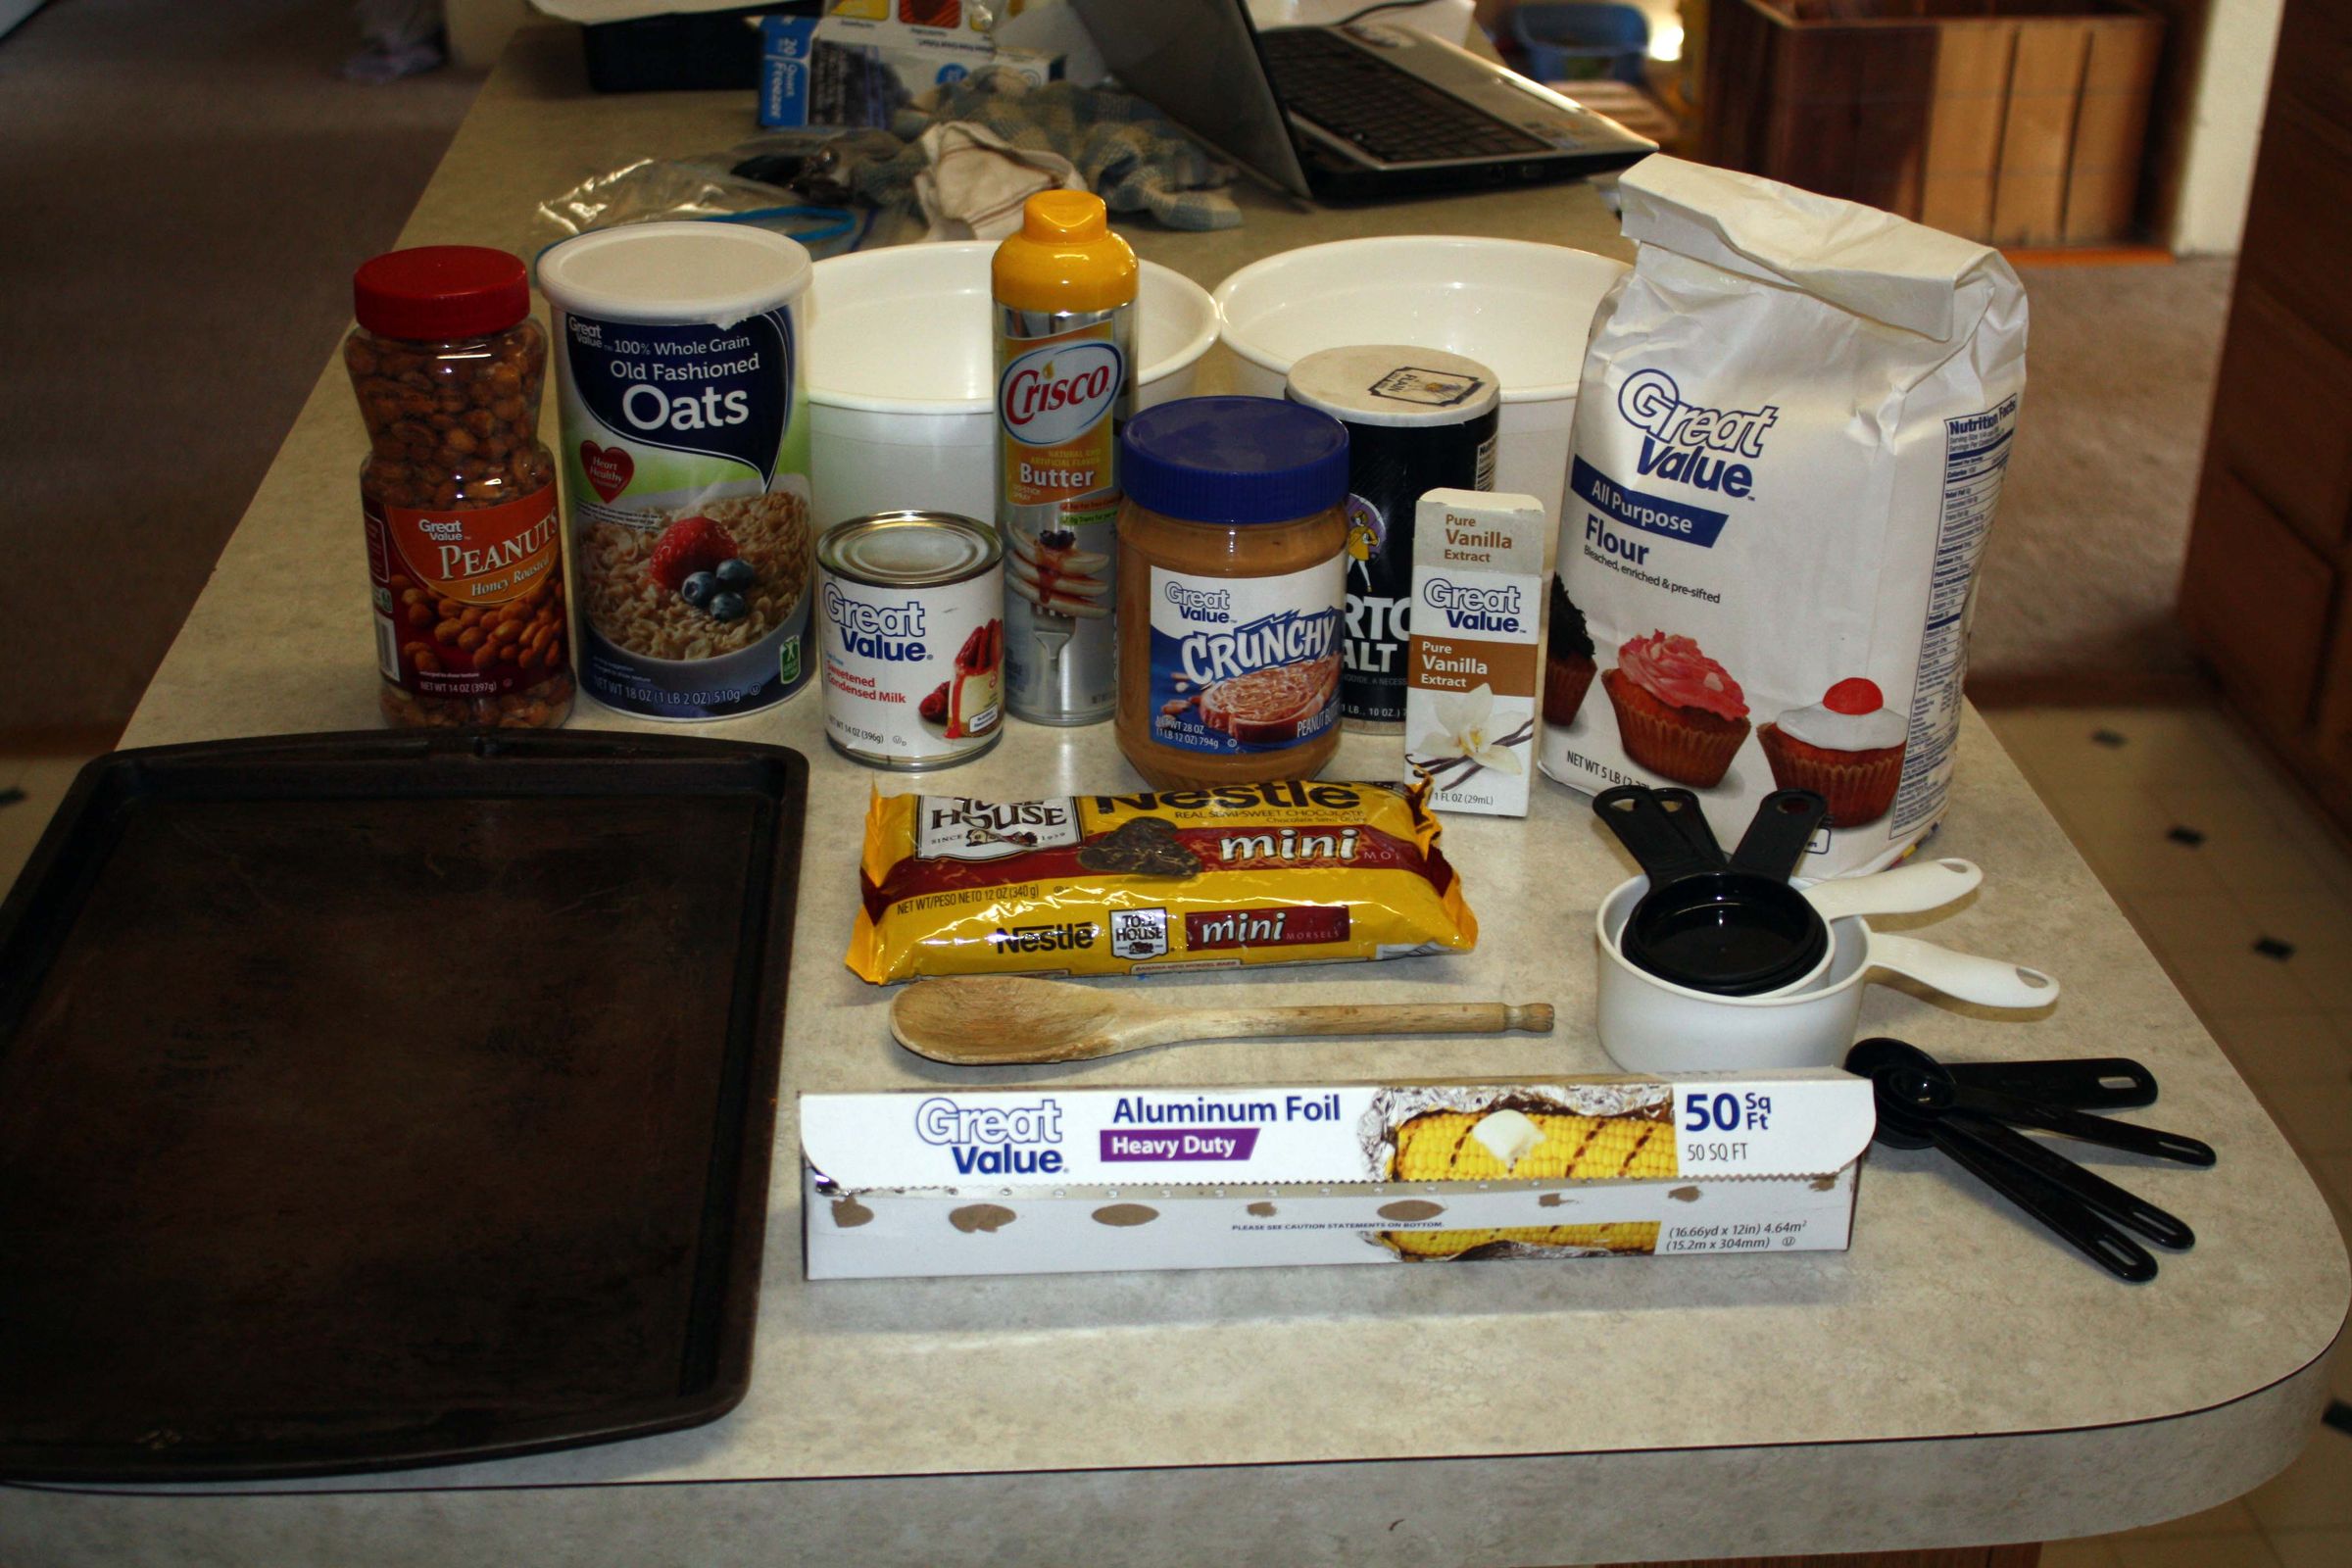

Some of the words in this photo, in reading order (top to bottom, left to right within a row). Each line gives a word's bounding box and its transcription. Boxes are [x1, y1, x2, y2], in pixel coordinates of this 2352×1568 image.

[568, 317, 602, 338] Great
[614, 340, 651, 355] 100%
[654, 339, 708, 356] Whole
[710, 335, 751, 353] Grain
[611, 360, 647, 379] Old
[654, 353, 760, 381] Fashioned
[1005, 365, 1109, 425] Crisco
[622, 384, 750, 431] Oats
[1618, 368, 1780, 459] Great
[1948, 414, 1998, 435] Nutrition
[593, 456, 618, 470] Heart
[1637, 434, 1753, 498] Value
[1020, 463, 1095, 487] Butter
[1592, 479, 1610, 505] All
[1611, 492, 1692, 534] Purpose
[418, 518, 462, 533] Great
[1446, 514, 1476, 527] Pure
[430, 532, 463, 541] Value
[438, 507, 558, 580] PEANUTS
[1446, 528, 1513, 549] Vanilla
[1586, 513, 1649, 565] Flour
[1444, 549, 1491, 563] Extract
[471, 578, 510, 597] Honey
[514, 555, 550, 584] Roasted
[1584, 544, 1620, 572] Bleached,
[1621, 565, 1660, 587] enriched
[1661, 578, 1671, 589] &
[1671, 583, 1721, 604] pre-sifted
[1164, 581, 1230, 611] Great
[1424, 577, 1521, 614] Great
[823, 582, 925, 638] Great
[1180, 605, 1230, 624] Value
[1446, 609, 1519, 632] Value
[841, 627, 926, 662] Value
[1182, 613, 1337, 687] CRUNCHY
[1343, 639, 1397, 673] ALT
[1422, 641, 1452, 655] Pure
[1422, 654, 1488, 675] Vanilla
[449, 683, 459, 693] 14
[459, 683, 470, 693] OZ
[470, 681, 497, 694] (397g)
[1421, 673, 1467, 687] Extract
[626, 686, 637, 700] 18
[638, 689, 652, 703] OZ
[667, 692, 680, 705] LB
[683, 693, 690, 705] 2
[692, 692, 711, 706] OZ)
[713, 689, 741, 705] 510g
[879, 691, 906, 704] Milk
[1183, 722, 1193, 733] 28
[1194, 723, 1204, 734] OZ
[1298, 713, 1325, 738] PEANUT
[1185, 734, 1198, 746] OZ)
[1200, 736, 1219, 750] 794g
[1567, 750, 1584, 768] NET
[1584, 759, 1600, 775] WT
[1601, 766, 1607, 779] 5
[1609, 769, 1621, 785] LB
[1441, 793, 1449, 803] FL
[1451, 794, 1463, 804] OZ
[1464, 793, 1494, 806] (29mL)
[931, 806, 1067, 831] HOUSE
[1176, 810, 1206, 819] REAL
[1208, 809, 1282, 819] SEMI-SWEET
[931, 834, 963, 845] SINCE
[1221, 828, 1360, 861] mini
[897, 900, 914, 915] NET
[915, 893, 956, 910] WT/PESO
[958, 890, 980, 904] NETO
[984, 890, 995, 901] 12
[996, 888, 1007, 899] OZ
[1115, 926, 1164, 943] HOUSE
[1201, 912, 1287, 944] mini
[1286, 929, 1341, 941] MORSELS
[1112, 1097, 1275, 1124] Aluminum
[1286, 1095, 1342, 1122] Foil
[1685, 1093, 1740, 1132] 50
[1745, 1092, 1772, 1114] Sq
[916, 1098, 1063, 1145] Great
[1746, 1112, 1769, 1130] Ft
[1111, 1135, 1179, 1158] Heavy
[1183, 1134, 1237, 1158] Duty
[1688, 1144, 1704, 1161] 50
[1709, 1143, 1729, 1162] SQ
[1733, 1143, 1748, 1160] FT
[950, 1145, 1063, 1174] Value
[1669, 1226, 1719, 1238] (16.66yd
[1733, 1222, 1761, 1235] 12in)
[1666, 1240, 1706, 1251] (15.2m
[1720, 1238, 1770, 1250] 304mm)
